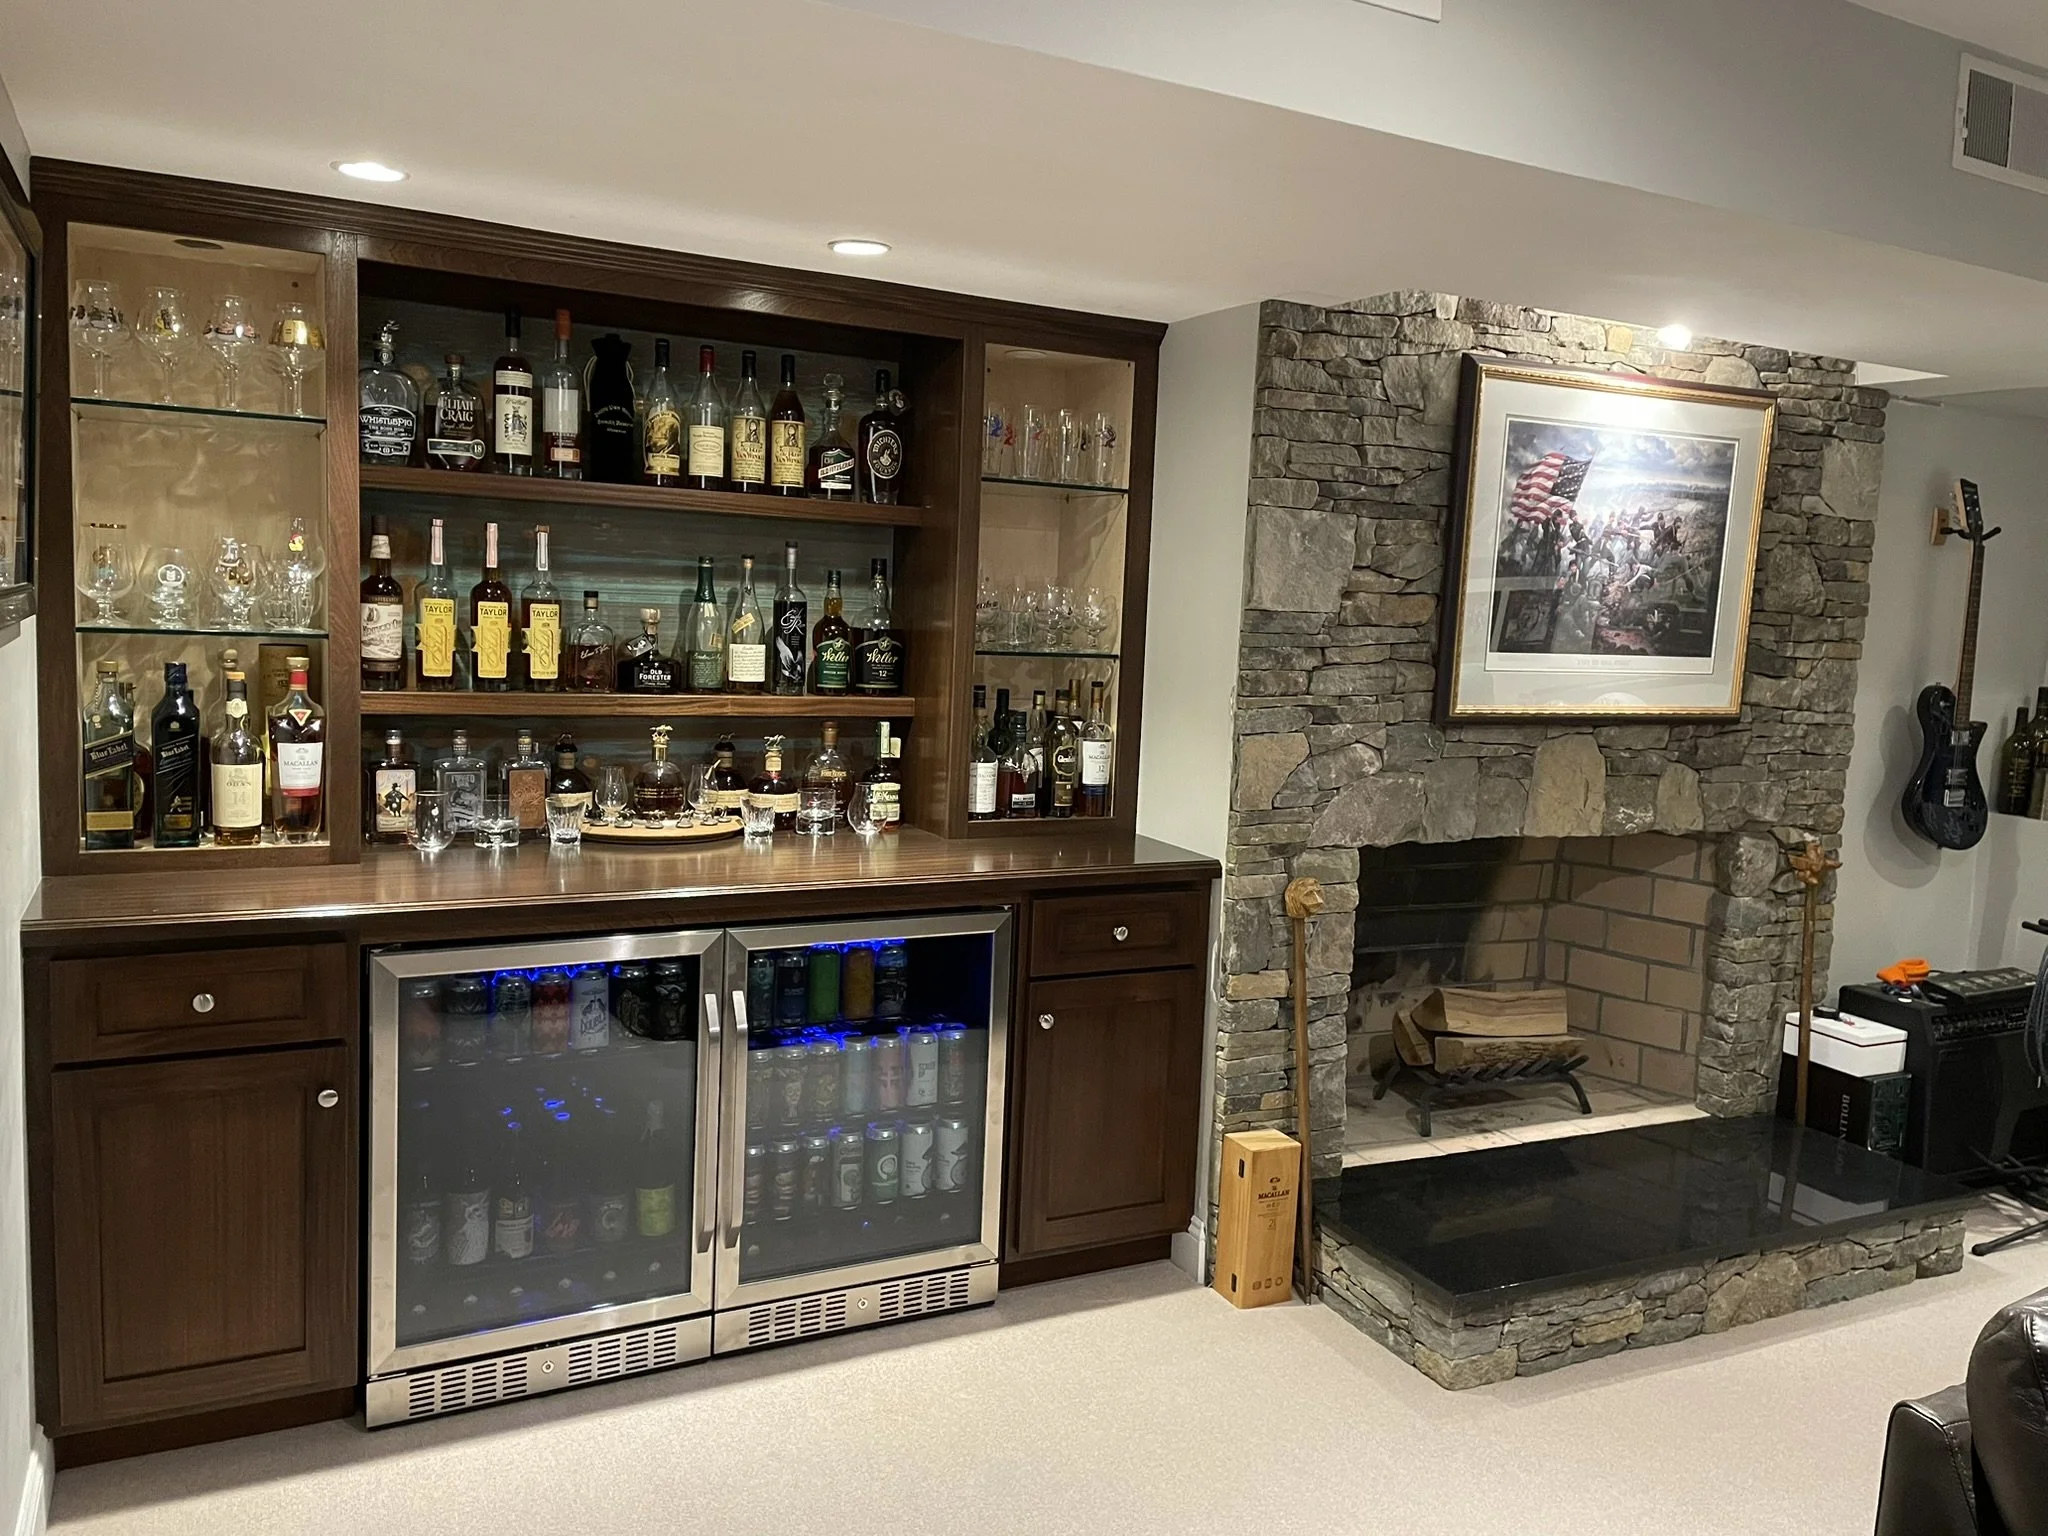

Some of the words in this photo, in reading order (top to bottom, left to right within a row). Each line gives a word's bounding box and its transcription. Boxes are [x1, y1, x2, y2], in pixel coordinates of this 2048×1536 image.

[440, 396, 473, 411] ELIJAH
[440, 408, 474, 423] CRAIG
[473, 444, 483, 454] 18
[425, 605, 453, 614] TAYLOR
[480, 607, 507, 616] TAYLOR
[532, 610, 558, 618] TAYLOR
[639, 673, 671, 681] FORESTER
[878, 670, 888, 678] 12
[108, 742, 129, 755] Label
[1257, 1189, 1290, 1199] MACALLAN
